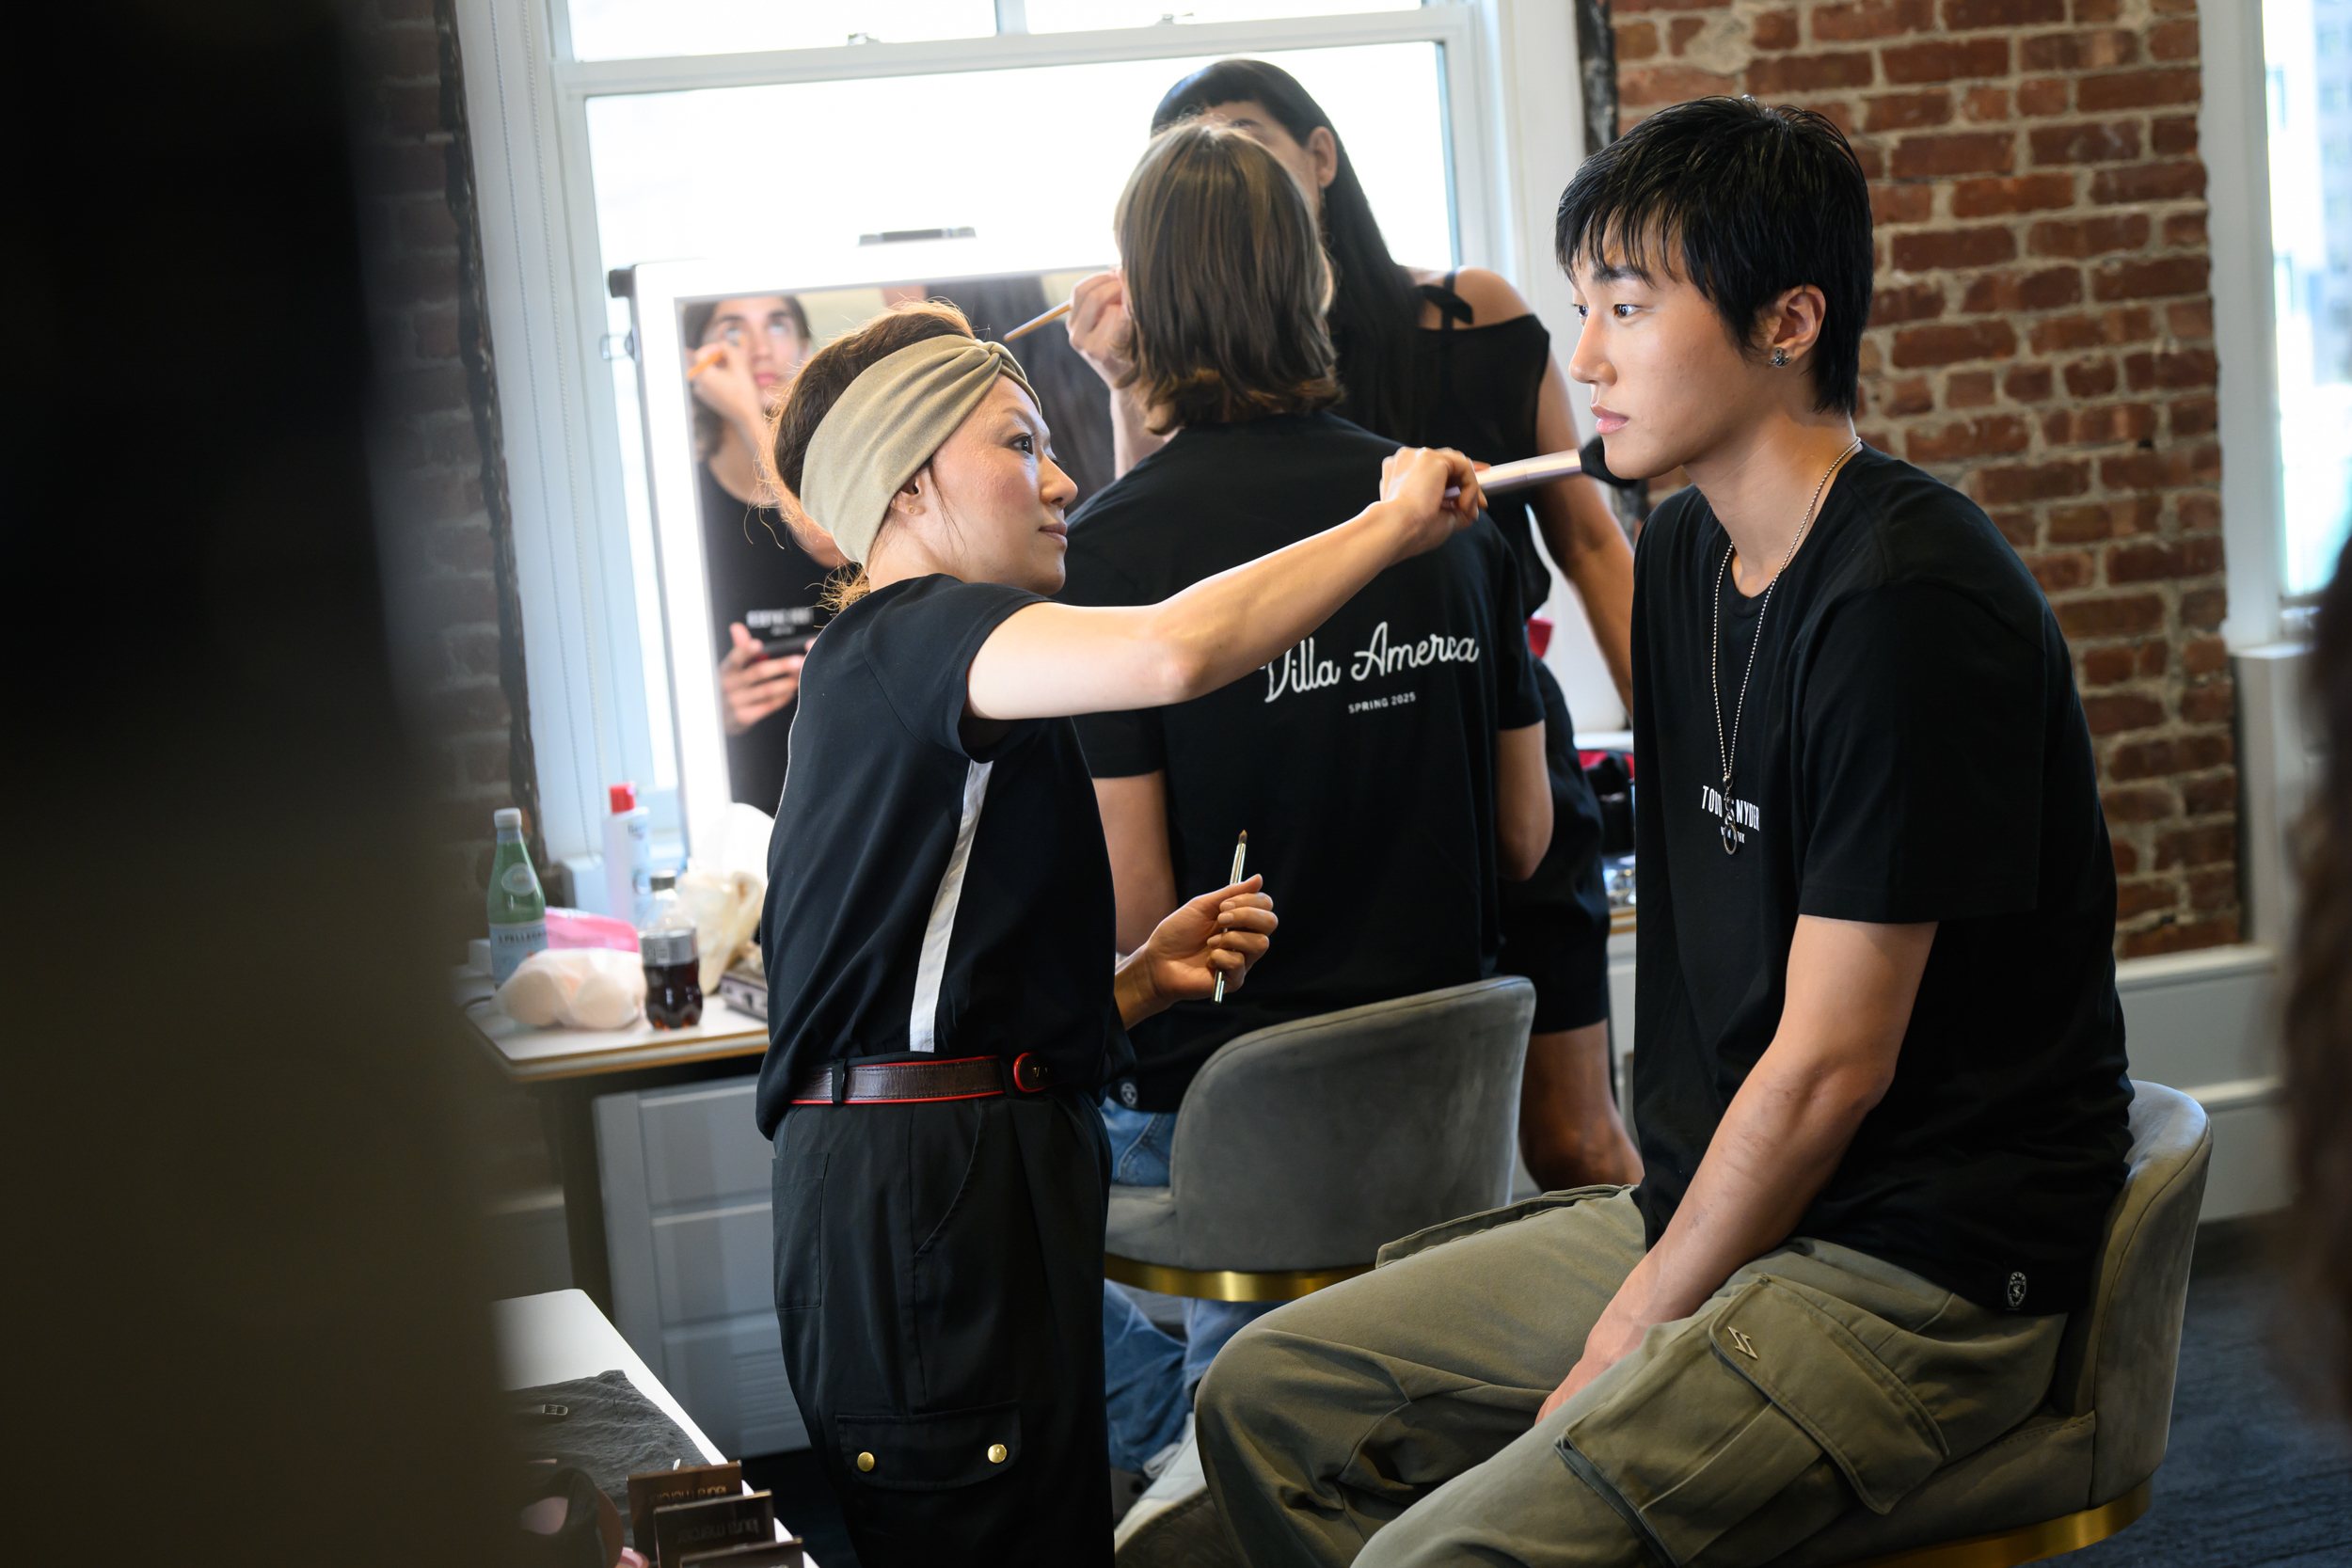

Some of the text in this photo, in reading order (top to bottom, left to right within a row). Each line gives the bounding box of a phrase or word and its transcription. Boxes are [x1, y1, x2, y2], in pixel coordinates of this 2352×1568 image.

[1259, 621, 1480, 703] Villa Amerca
[1348, 691, 1416, 714] SPRING 2025
